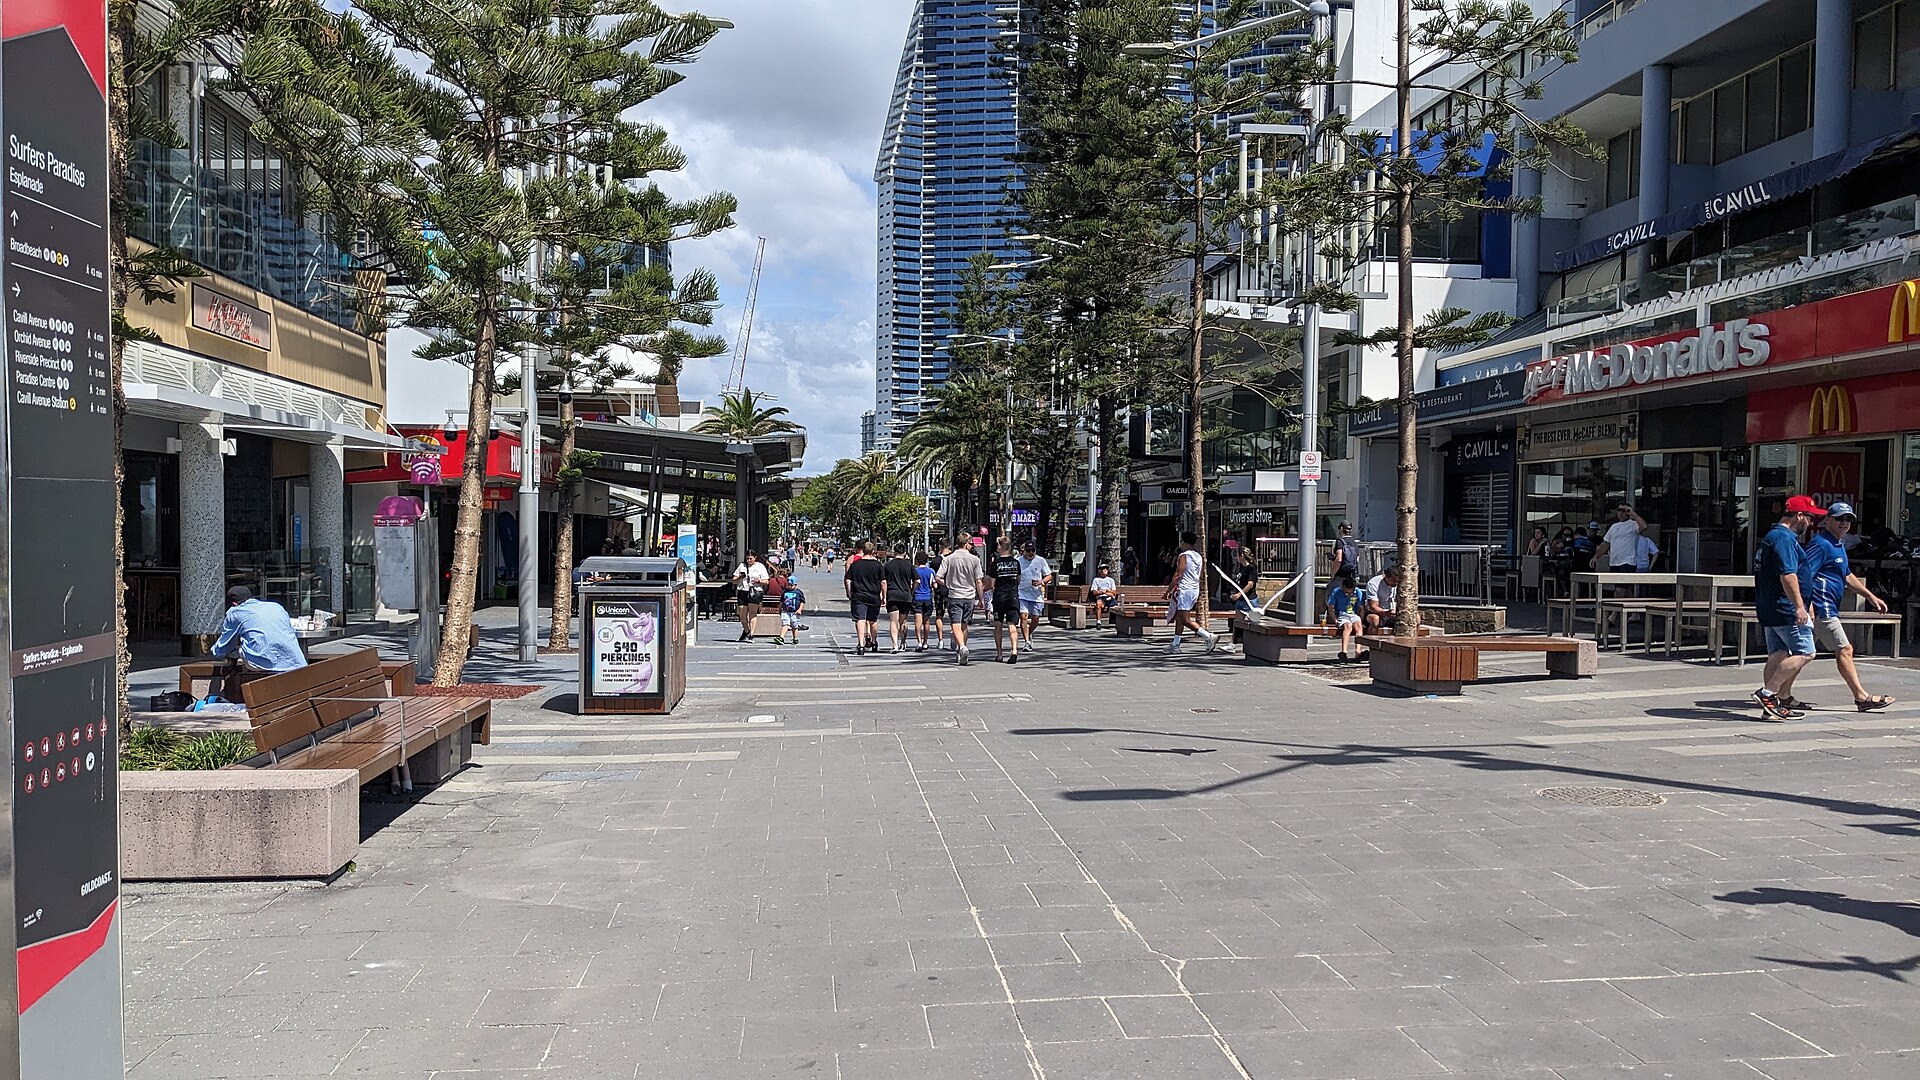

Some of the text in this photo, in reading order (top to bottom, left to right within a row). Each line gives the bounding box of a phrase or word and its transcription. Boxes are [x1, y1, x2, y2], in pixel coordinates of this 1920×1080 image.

[10, 134, 85, 188] Surfers Paradise
[10, 167, 44, 194] Esplanade
[1712, 181, 1771, 216] CAVILL
[1613, 220, 1656, 250] CAVILL
[10, 237, 43, 259] Broadbeach
[13, 309, 48, 329] Cavill Avenue
[14, 330, 51, 349] Orchid Avenue
[15, 350, 60, 370] Riverside Precinct
[1564, 318, 1770, 396] McDonald's
[16, 370, 56, 389] Paradise Centre
[17, 390, 69, 409] Cavill Avenue Station
[1427, 392, 1463, 408] RESTAURANT
[1357, 408, 1382, 425] CAVILL
[1533, 432, 1543, 444] THE
[1544, 430, 1556, 443] BEST
[1597, 423, 1617, 437] BLEND
[1464, 439, 1500, 459] CAVILL
[1017, 513, 1036, 523] MAZE
[1229, 508, 1273, 524] Universal Store
[23, 650, 40, 664] Surfers
[40, 648, 59, 661] Paradise
[61, 643, 84, 657] Esplanade
[614, 641, 638, 653] $40
[601, 653, 651, 662] PIERCINGS
